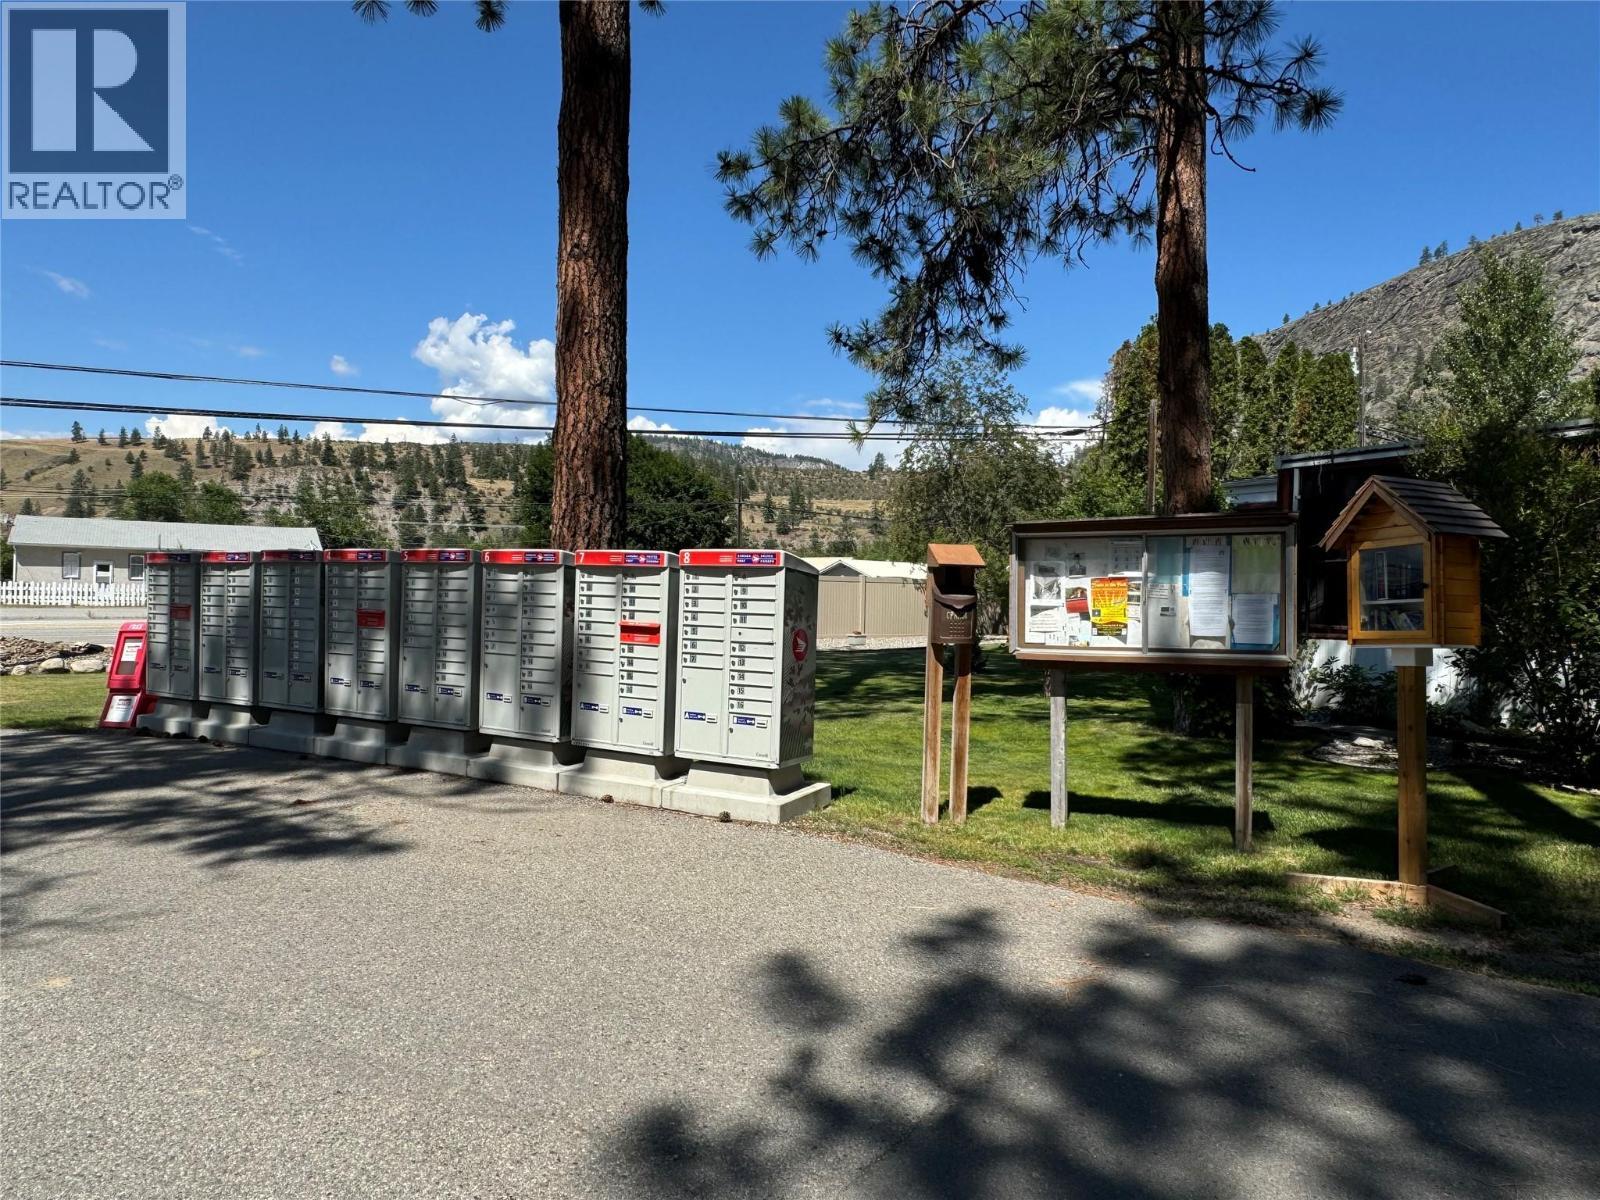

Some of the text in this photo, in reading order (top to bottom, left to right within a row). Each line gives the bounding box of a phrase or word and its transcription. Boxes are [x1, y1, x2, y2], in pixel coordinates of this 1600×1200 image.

[403, 551, 409, 561] 5
[484, 551, 490, 562] 6
[579, 552, 585, 564] 7
[684, 552, 691, 564] 8
